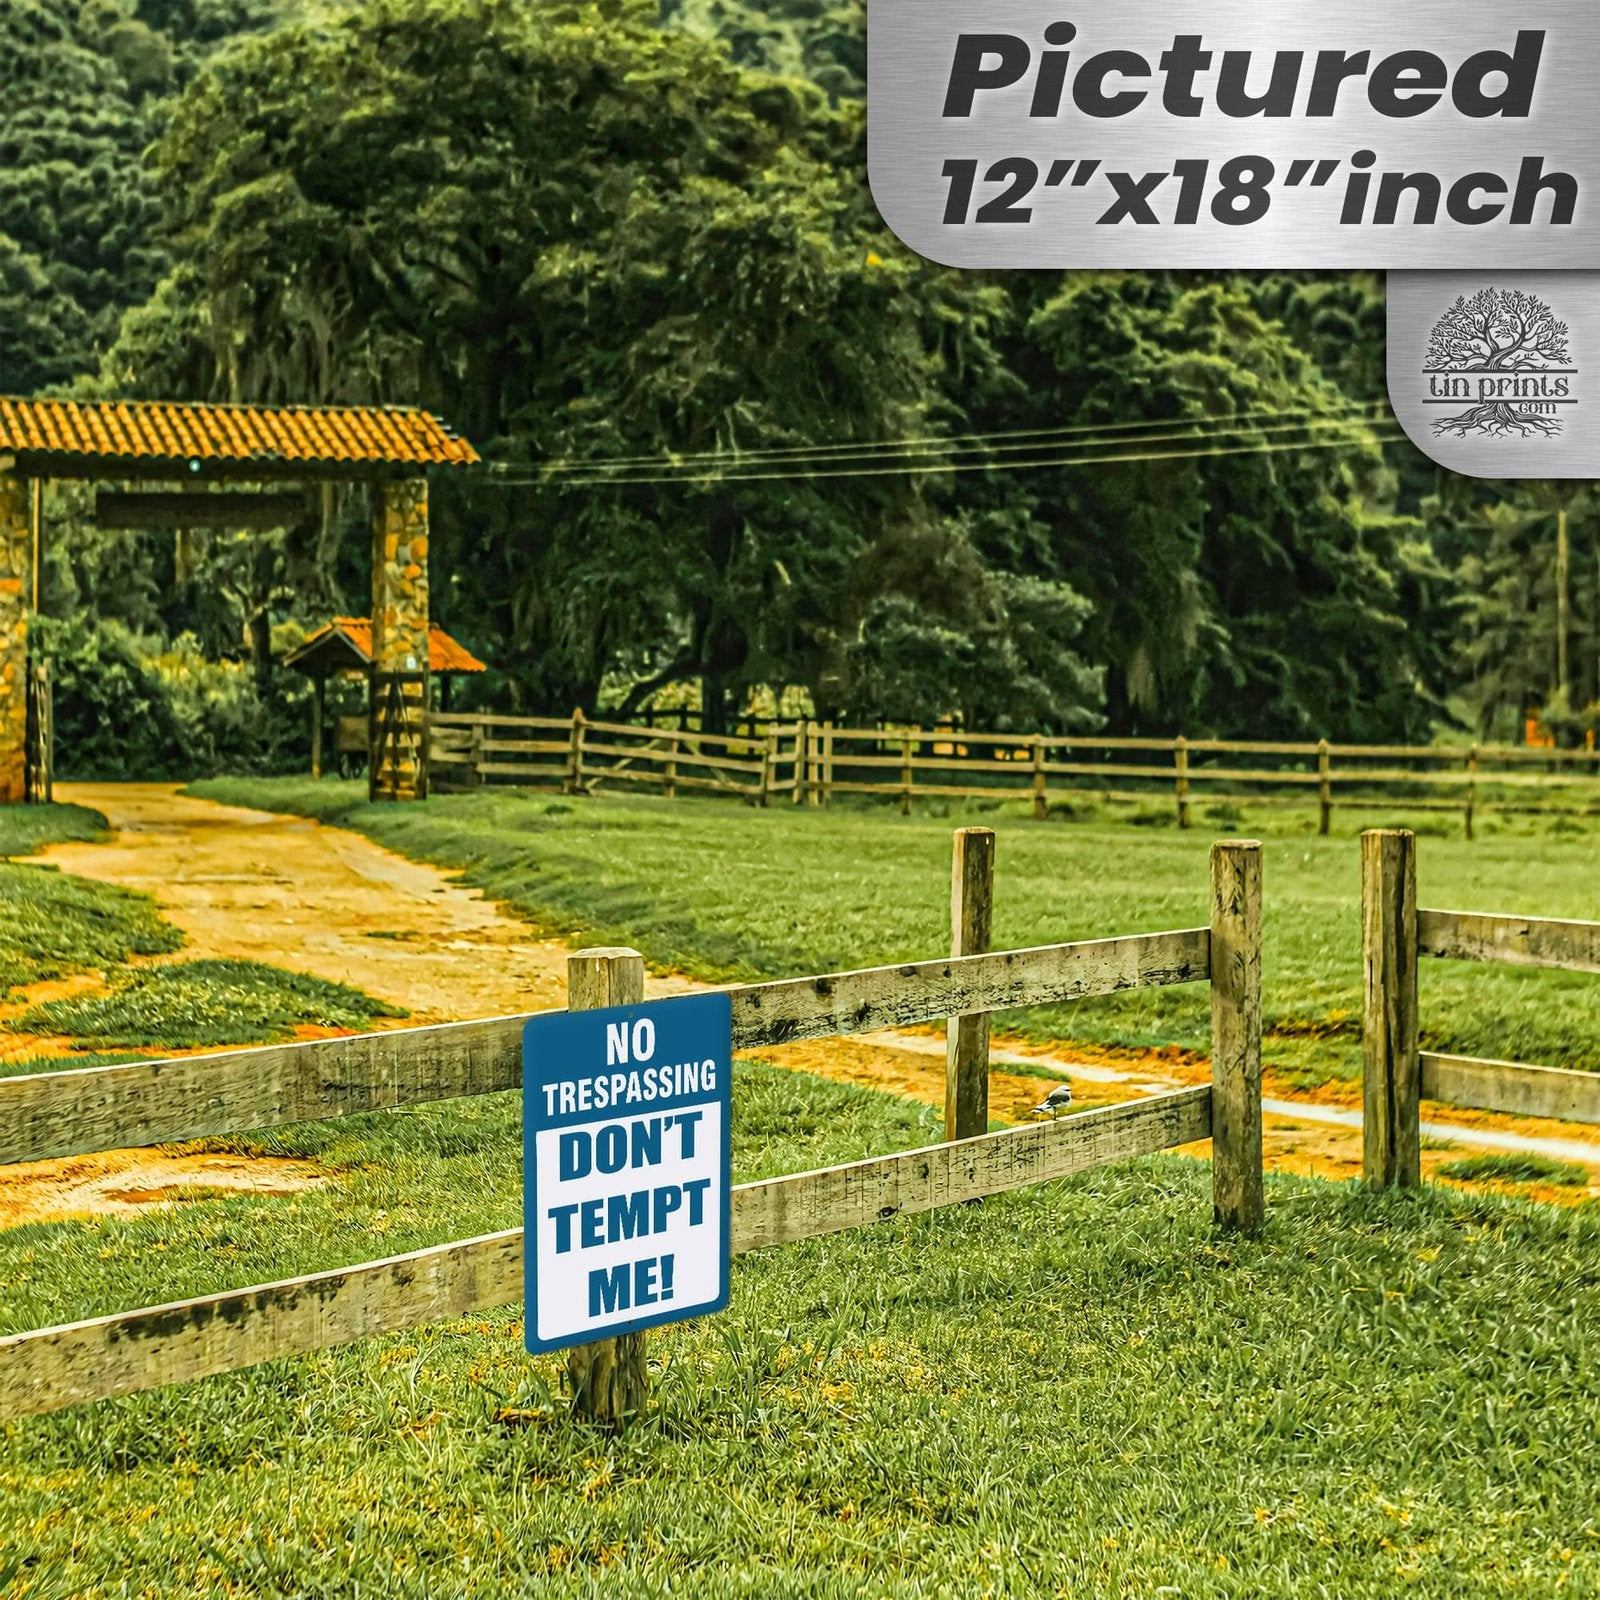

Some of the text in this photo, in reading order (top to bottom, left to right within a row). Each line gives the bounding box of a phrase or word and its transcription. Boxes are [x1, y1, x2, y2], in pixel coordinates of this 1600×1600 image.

[606, 1018, 655, 1066] NO
[542, 1059, 717, 1116] TRESPASSING
[559, 1111, 703, 1183] DON'T
[548, 1178, 711, 1254] TEMPT
[588, 1253, 675, 1318] ME!
